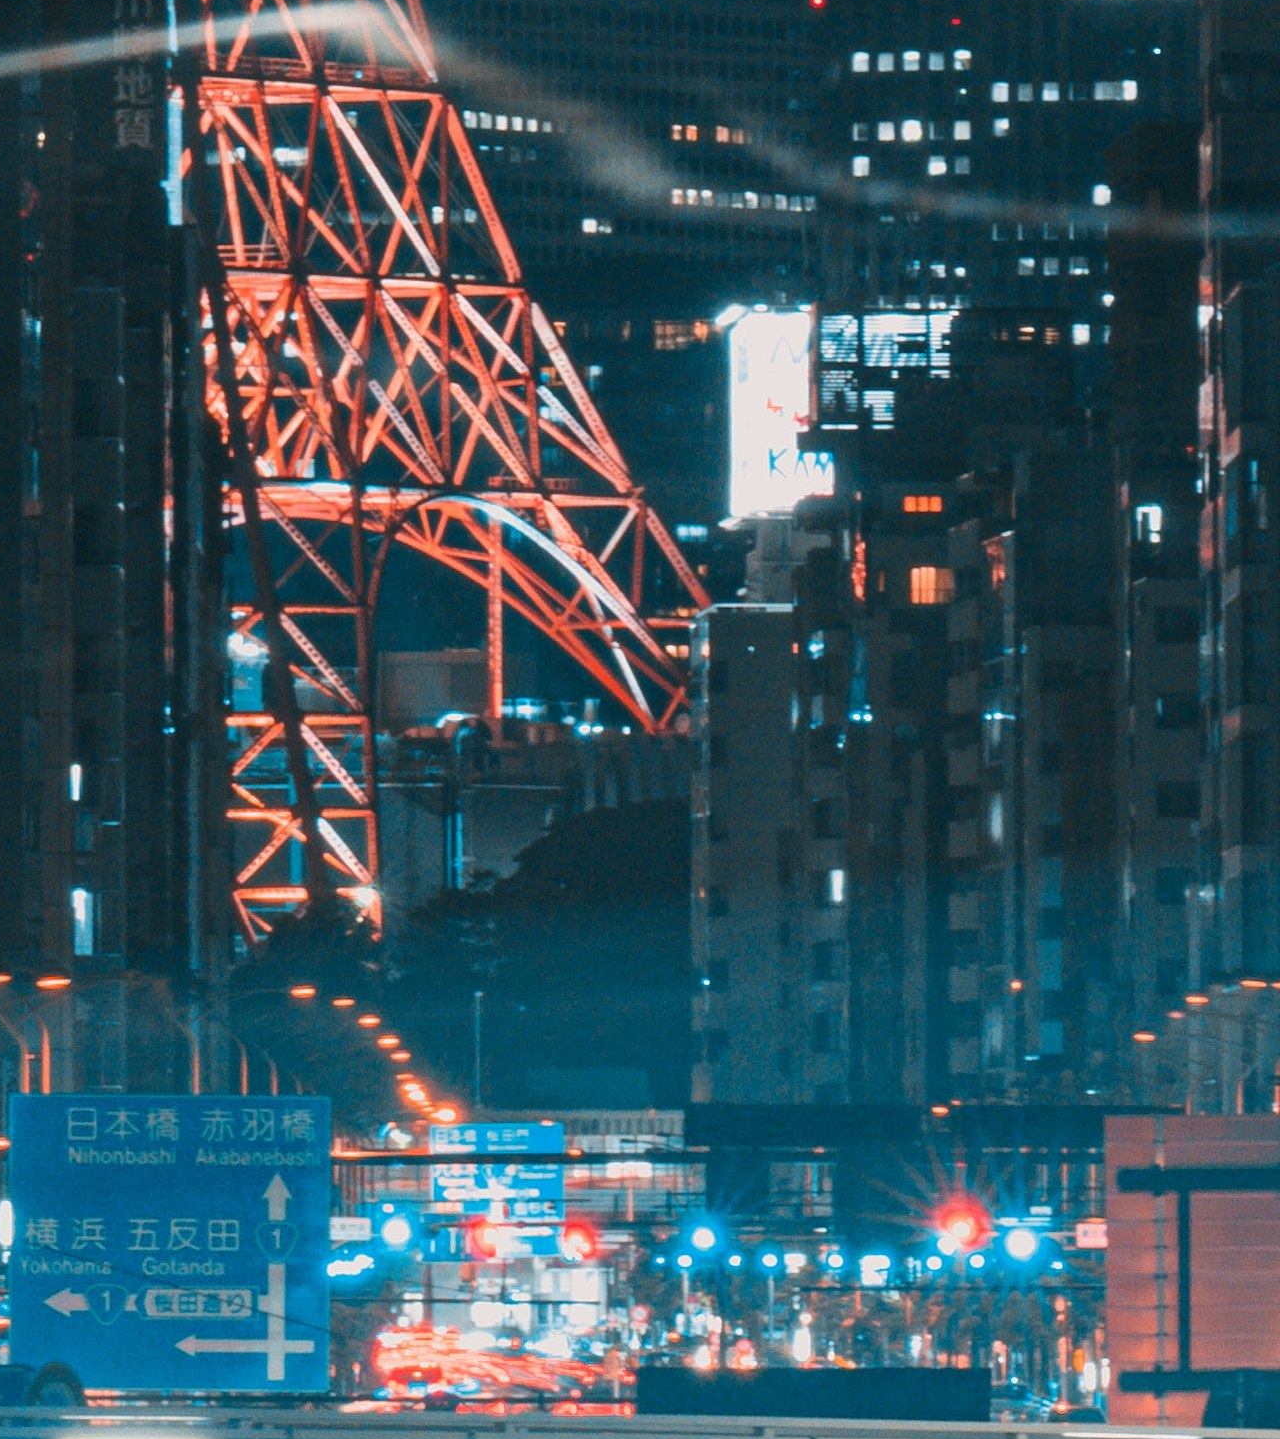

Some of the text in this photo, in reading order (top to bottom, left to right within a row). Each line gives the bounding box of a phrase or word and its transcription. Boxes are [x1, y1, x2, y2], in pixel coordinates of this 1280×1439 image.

[67, 1107, 316, 1142] 日本橋 赤羽橋
[68, 1147, 322, 1166] Nihonbashi Akabanebashi
[25, 1217, 241, 1252] 横浜 五反田
[271, 1228, 282, 1251] 1
[20, 1256, 226, 1277] Yokohama Gotanda
[101, 1289, 111, 1312] 1
